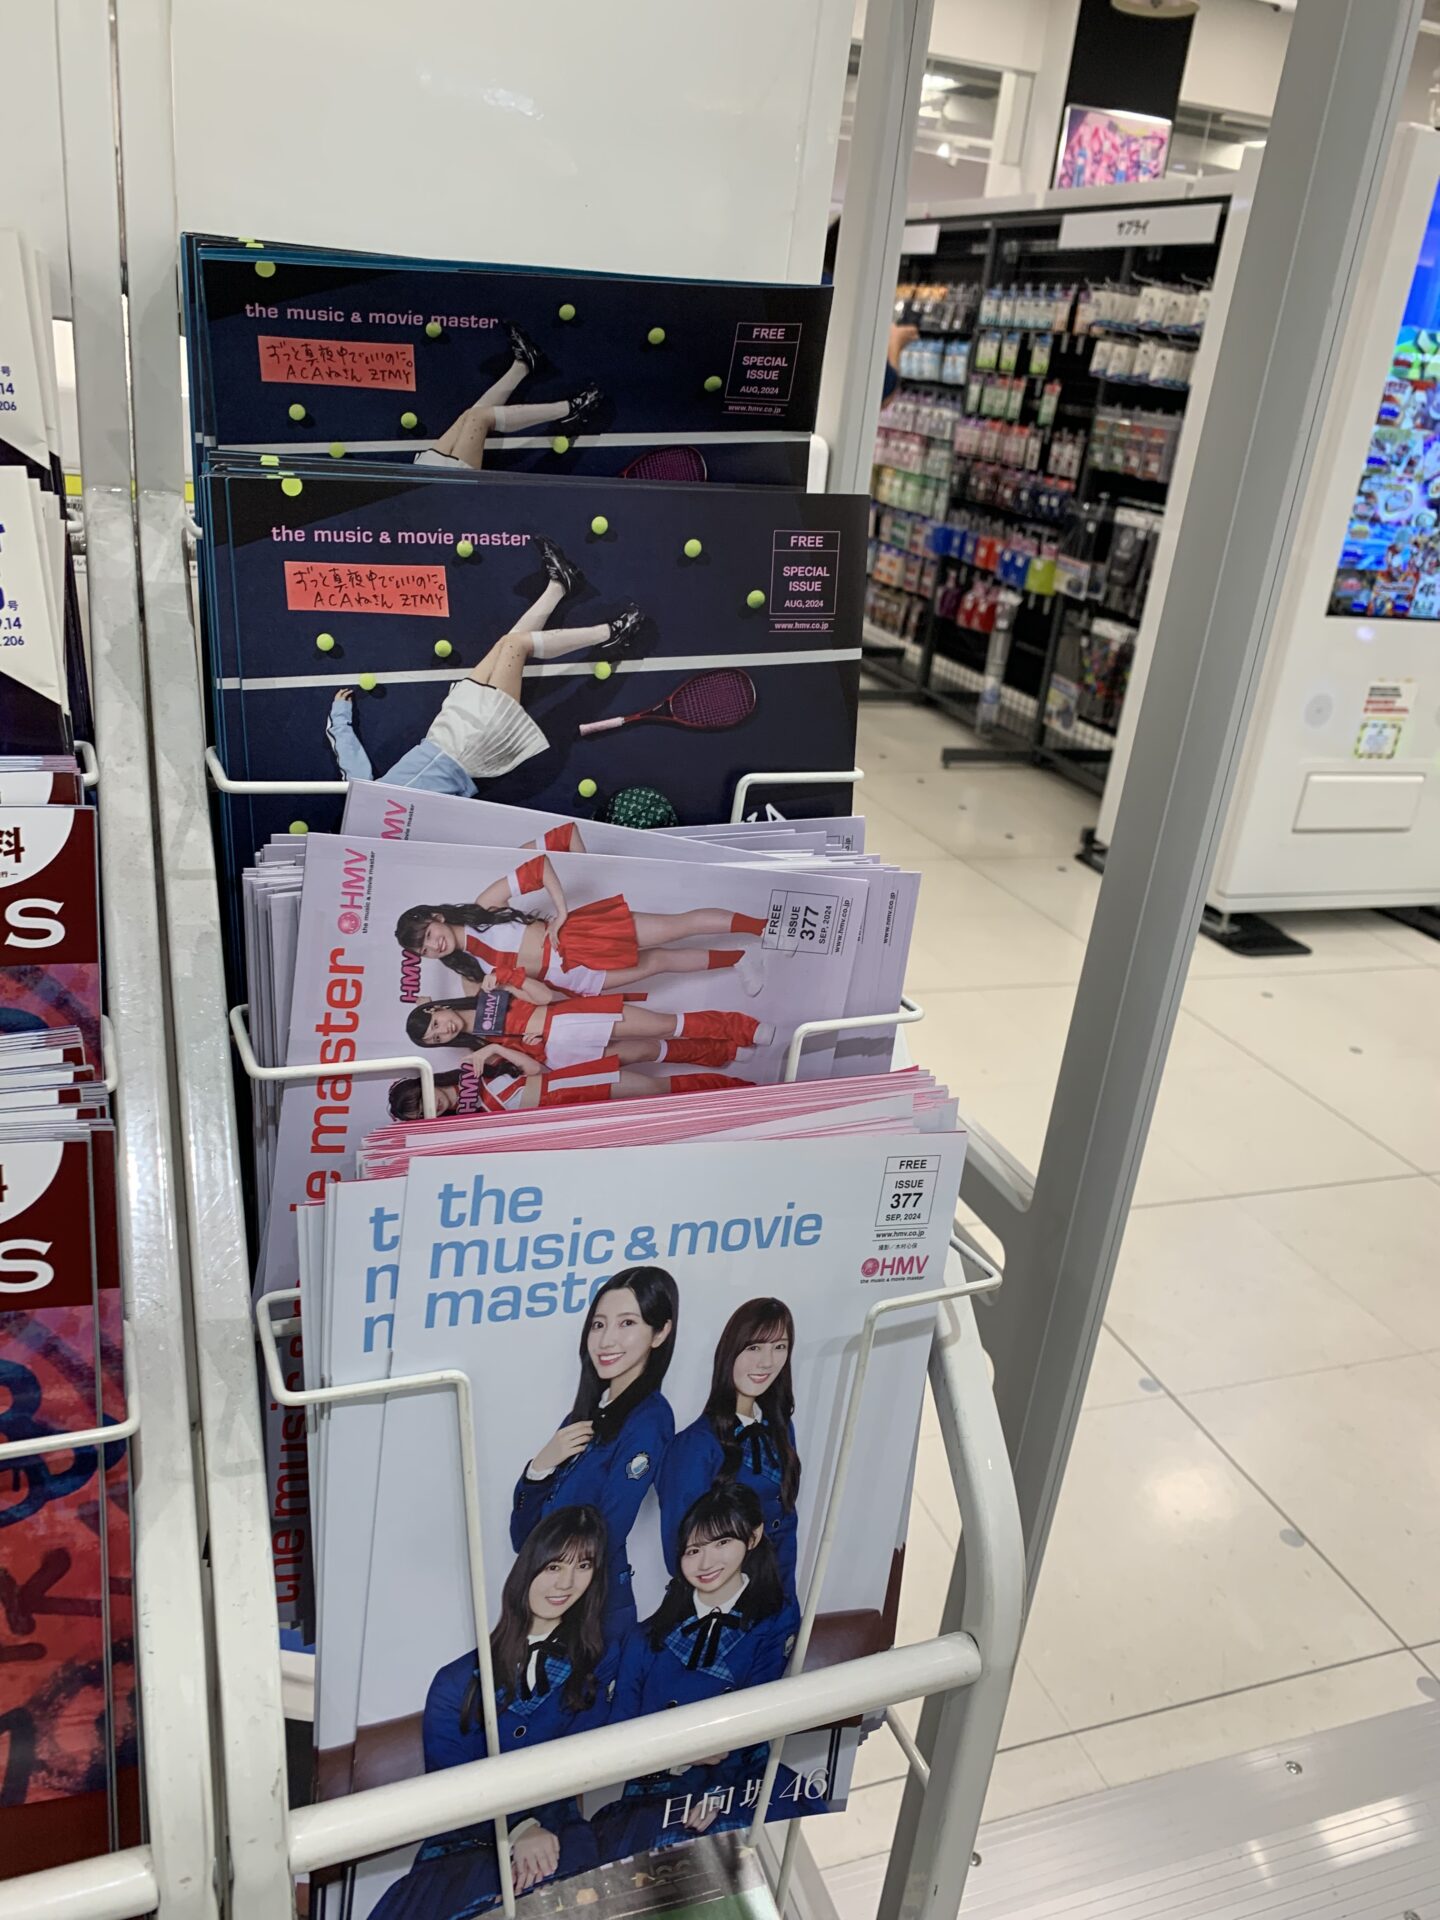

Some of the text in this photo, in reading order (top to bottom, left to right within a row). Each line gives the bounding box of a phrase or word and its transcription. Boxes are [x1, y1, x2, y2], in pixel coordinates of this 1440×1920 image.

[245, 303, 499, 329] the music & movie master
[752, 328, 786, 339] FREE
[742, 356, 789, 367] SPECIAL
[746, 370, 780, 380] ISSUE
[728, 405, 781, 414] www.hmv.co.jp
[271, 525, 531, 546] the music & movie master
[790, 535, 824, 547] FREE
[782, 566, 830, 577] SPECIAL
[789, 581, 822, 592] ISSUE
[400, 593, 443, 609] ZTMY
[774, 622, 829, 630] www.hmv.co.jp
[339, 848, 368, 910] HMV
[768, 904, 783, 936] FREE
[786, 906, 801, 938] ISSUE
[800, 906, 820, 941] 377
[822, 905, 832, 925] 2024
[834, 900, 850, 953] www.hmv.co.jp
[400, 949, 422, 1004] HMV
[483, 993, 498, 1018] HMV
[310, 947, 365, 1154] master
[899, 1160, 927, 1170] FREE
[894, 1179, 924, 1189] ISSUE
[437, 1174, 543, 1229] the
[890, 1192, 923, 1209] 377
[904, 1212, 921, 1221] 2024
[429, 1217, 616, 1280] music
[624, 1226, 660, 1261] &
[667, 1202, 824, 1258] movie
[876, 1230, 925, 1239] www.hmv.co.jp
[880, 1255, 930, 1276] HMV
